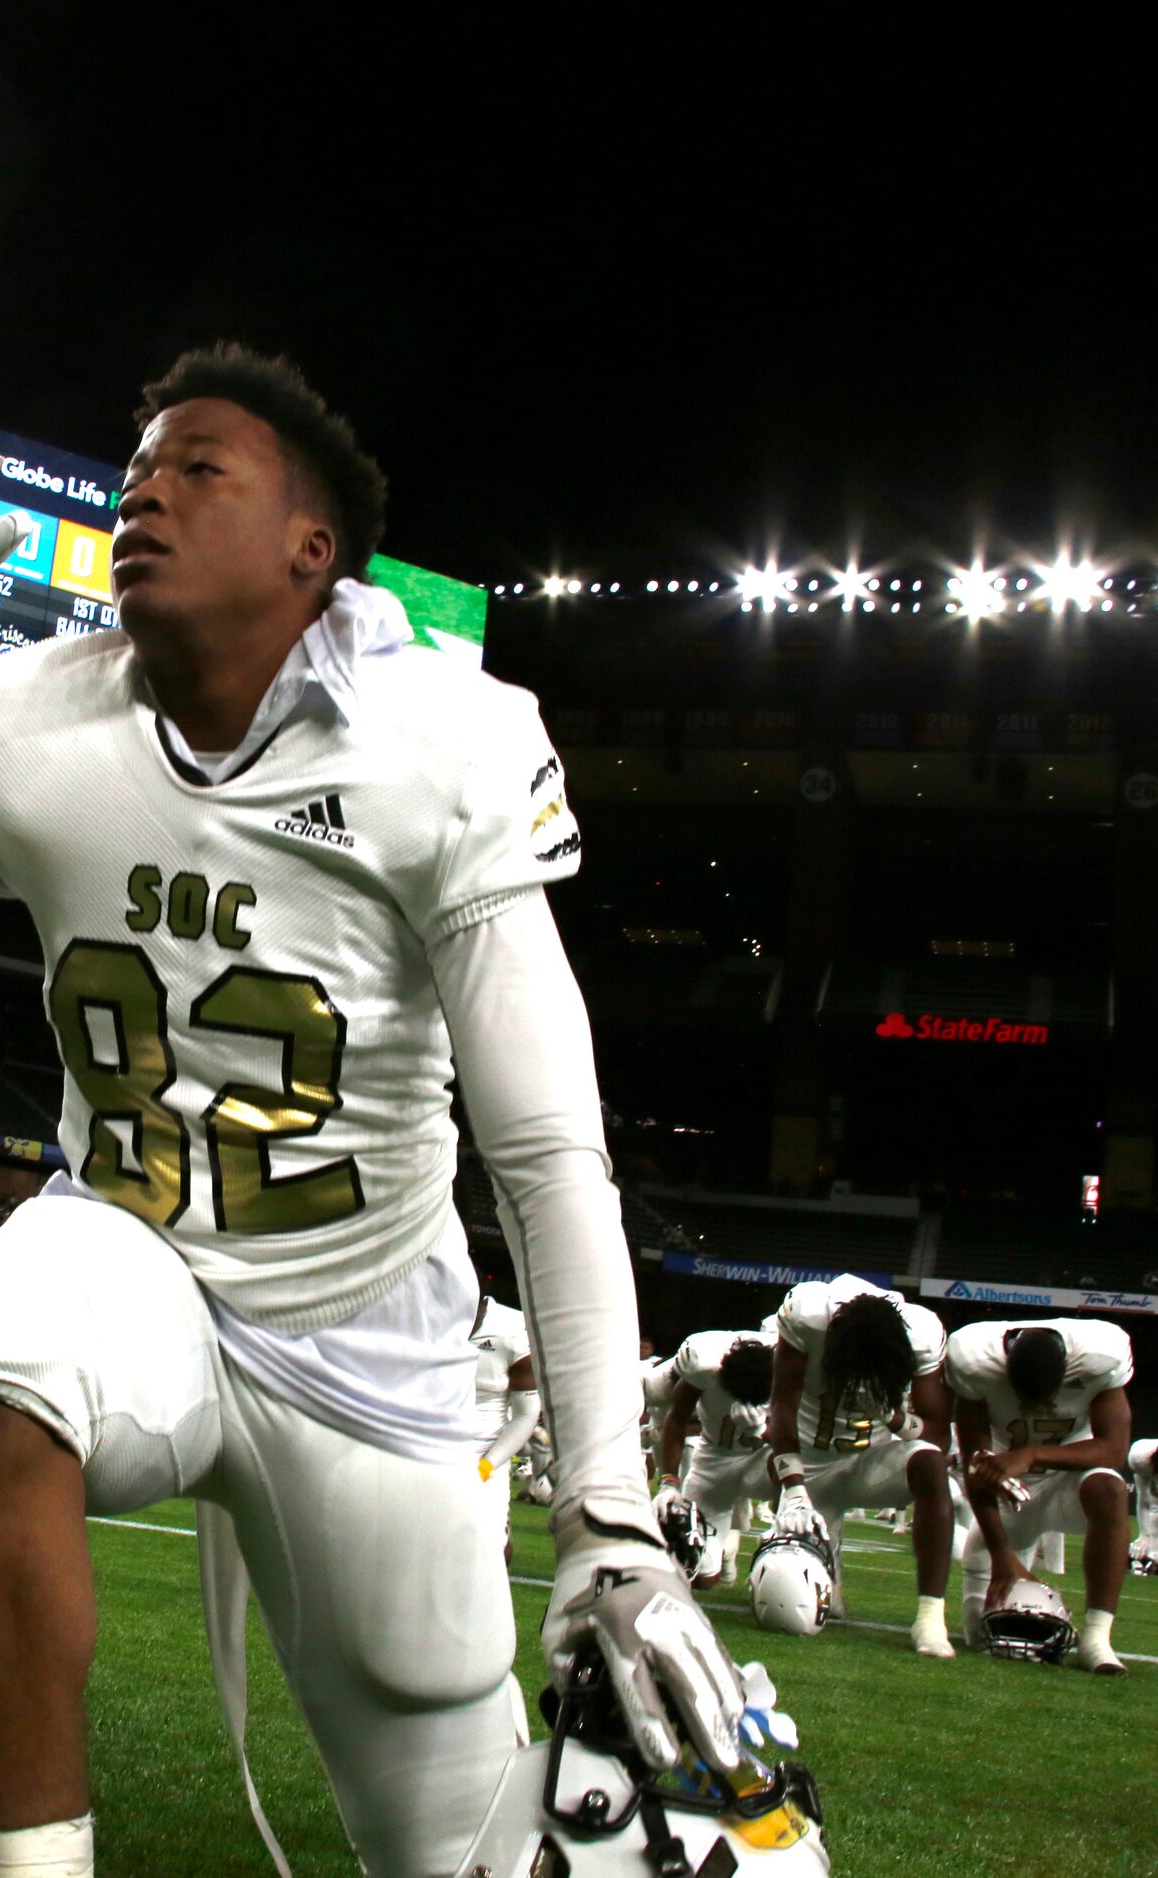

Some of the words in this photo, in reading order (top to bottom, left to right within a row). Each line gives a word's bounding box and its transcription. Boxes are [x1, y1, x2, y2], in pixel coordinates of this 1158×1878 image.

[1, 457, 64, 493] Globe
[67, 476, 107, 507] Life
[70, 536, 94, 578] 0
[73, 596, 98, 621] 1ST
[274, 815, 355, 849] adidas
[125, 864, 257, 951] SOC
[49, 937, 366, 1232] 82
[973, 1286, 1051, 1306] Albertsons
[1081, 1292, 1107, 1304] Tom
[1108, 1292, 1152, 1307] Thumb
